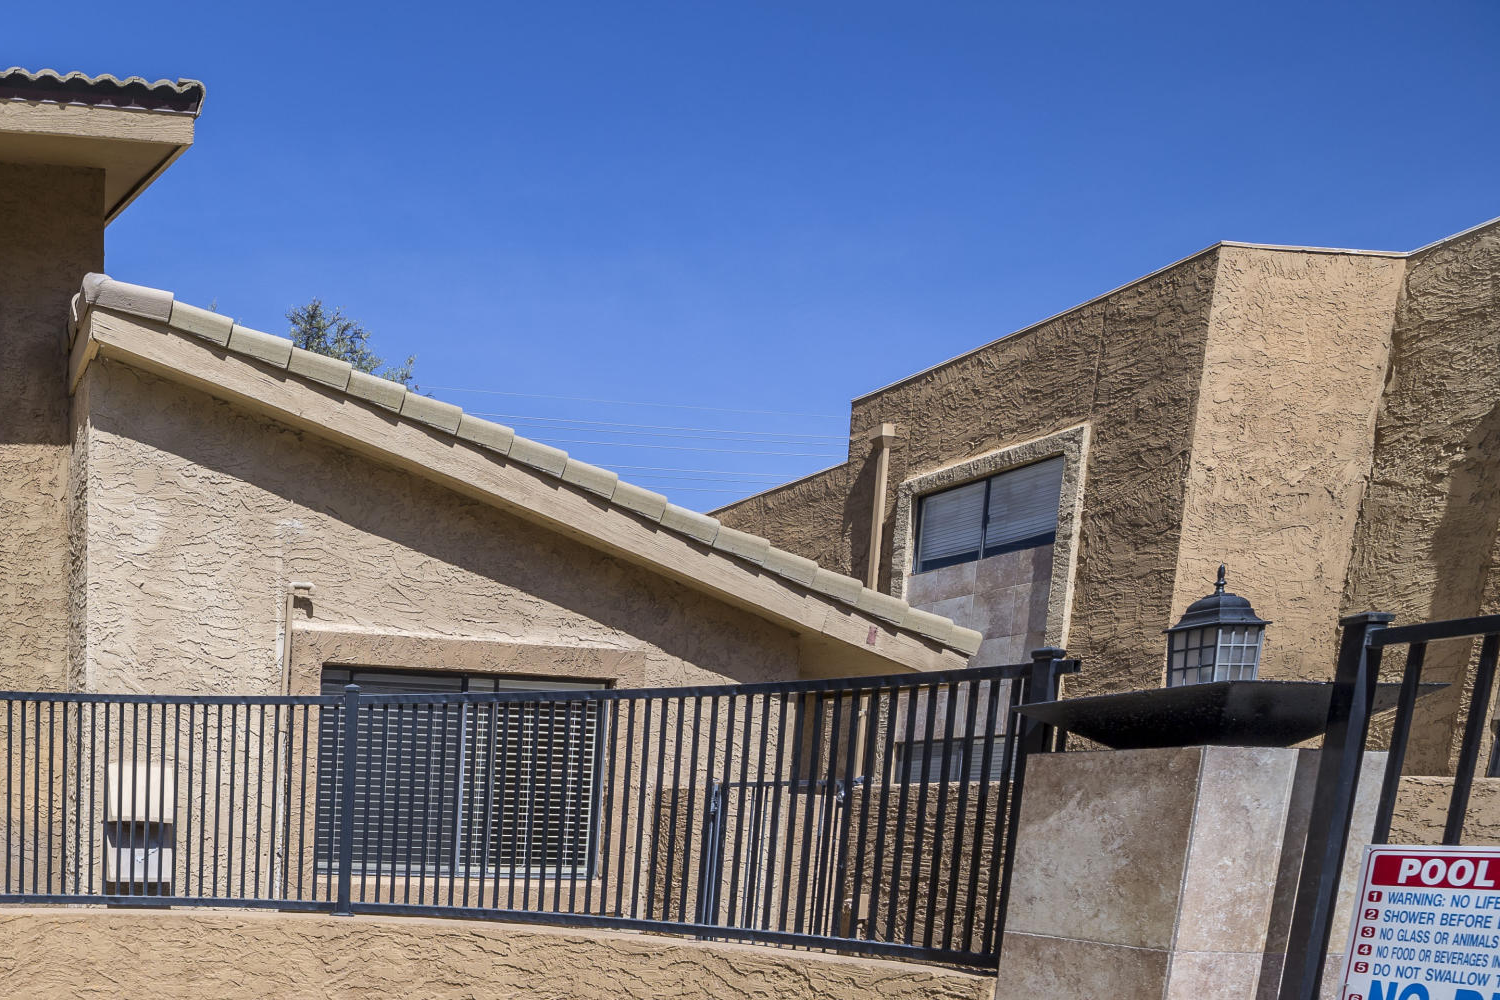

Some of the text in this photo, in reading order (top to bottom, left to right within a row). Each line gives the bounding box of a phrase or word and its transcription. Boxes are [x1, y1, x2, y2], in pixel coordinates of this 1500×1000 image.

[1397, 858, 1495, 887] POOL
[1388, 891, 1446, 907] WARNING:
[1450, 894, 1470, 908] NO
[1367, 910, 1376, 919] 2
[1383, 909, 1435, 925] SHOWER
[1440, 913, 1493, 929] BEFORE
[1363, 928, 1499, 949] 3 NO GLASS OR ANIMALS
[1359, 945, 1369, 954] 4
[1376, 945, 1389, 959] NO
[1391, 947, 1416, 960] FOOD
[1418, 949, 1431, 962] OR
[1434, 950, 1489, 968] BEVERAGES
[1356, 963, 1366, 972] 5
[1373, 963, 1391, 977] DO
[1395, 966, 1421, 979] NOT
[1425, 968, 1491, 986] SWALLOW
